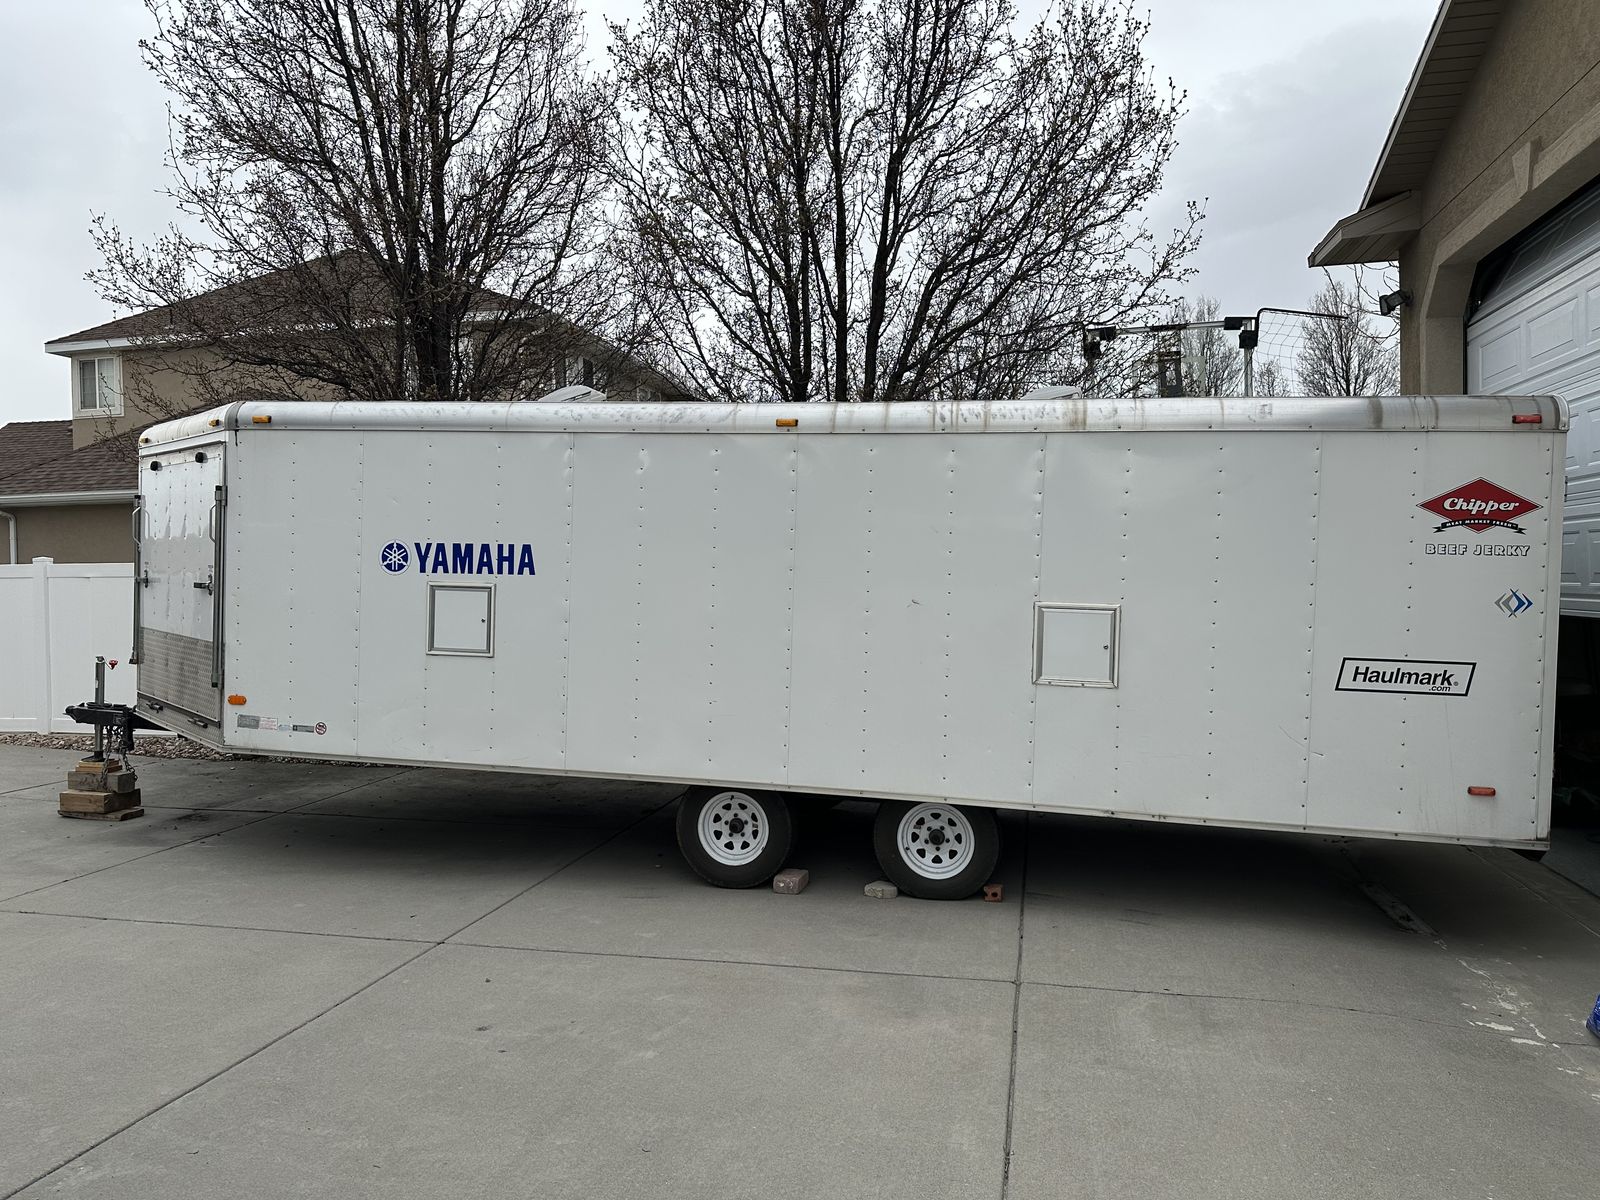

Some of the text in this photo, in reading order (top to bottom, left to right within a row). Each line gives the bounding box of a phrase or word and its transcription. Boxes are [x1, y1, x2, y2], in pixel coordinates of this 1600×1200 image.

[1443, 497, 1519, 515] Chipper
[414, 542, 536, 576] YAMAHA
[1425, 543, 1530, 557] BEEF JERKY
[1352, 666, 1455, 686] Haulmark
